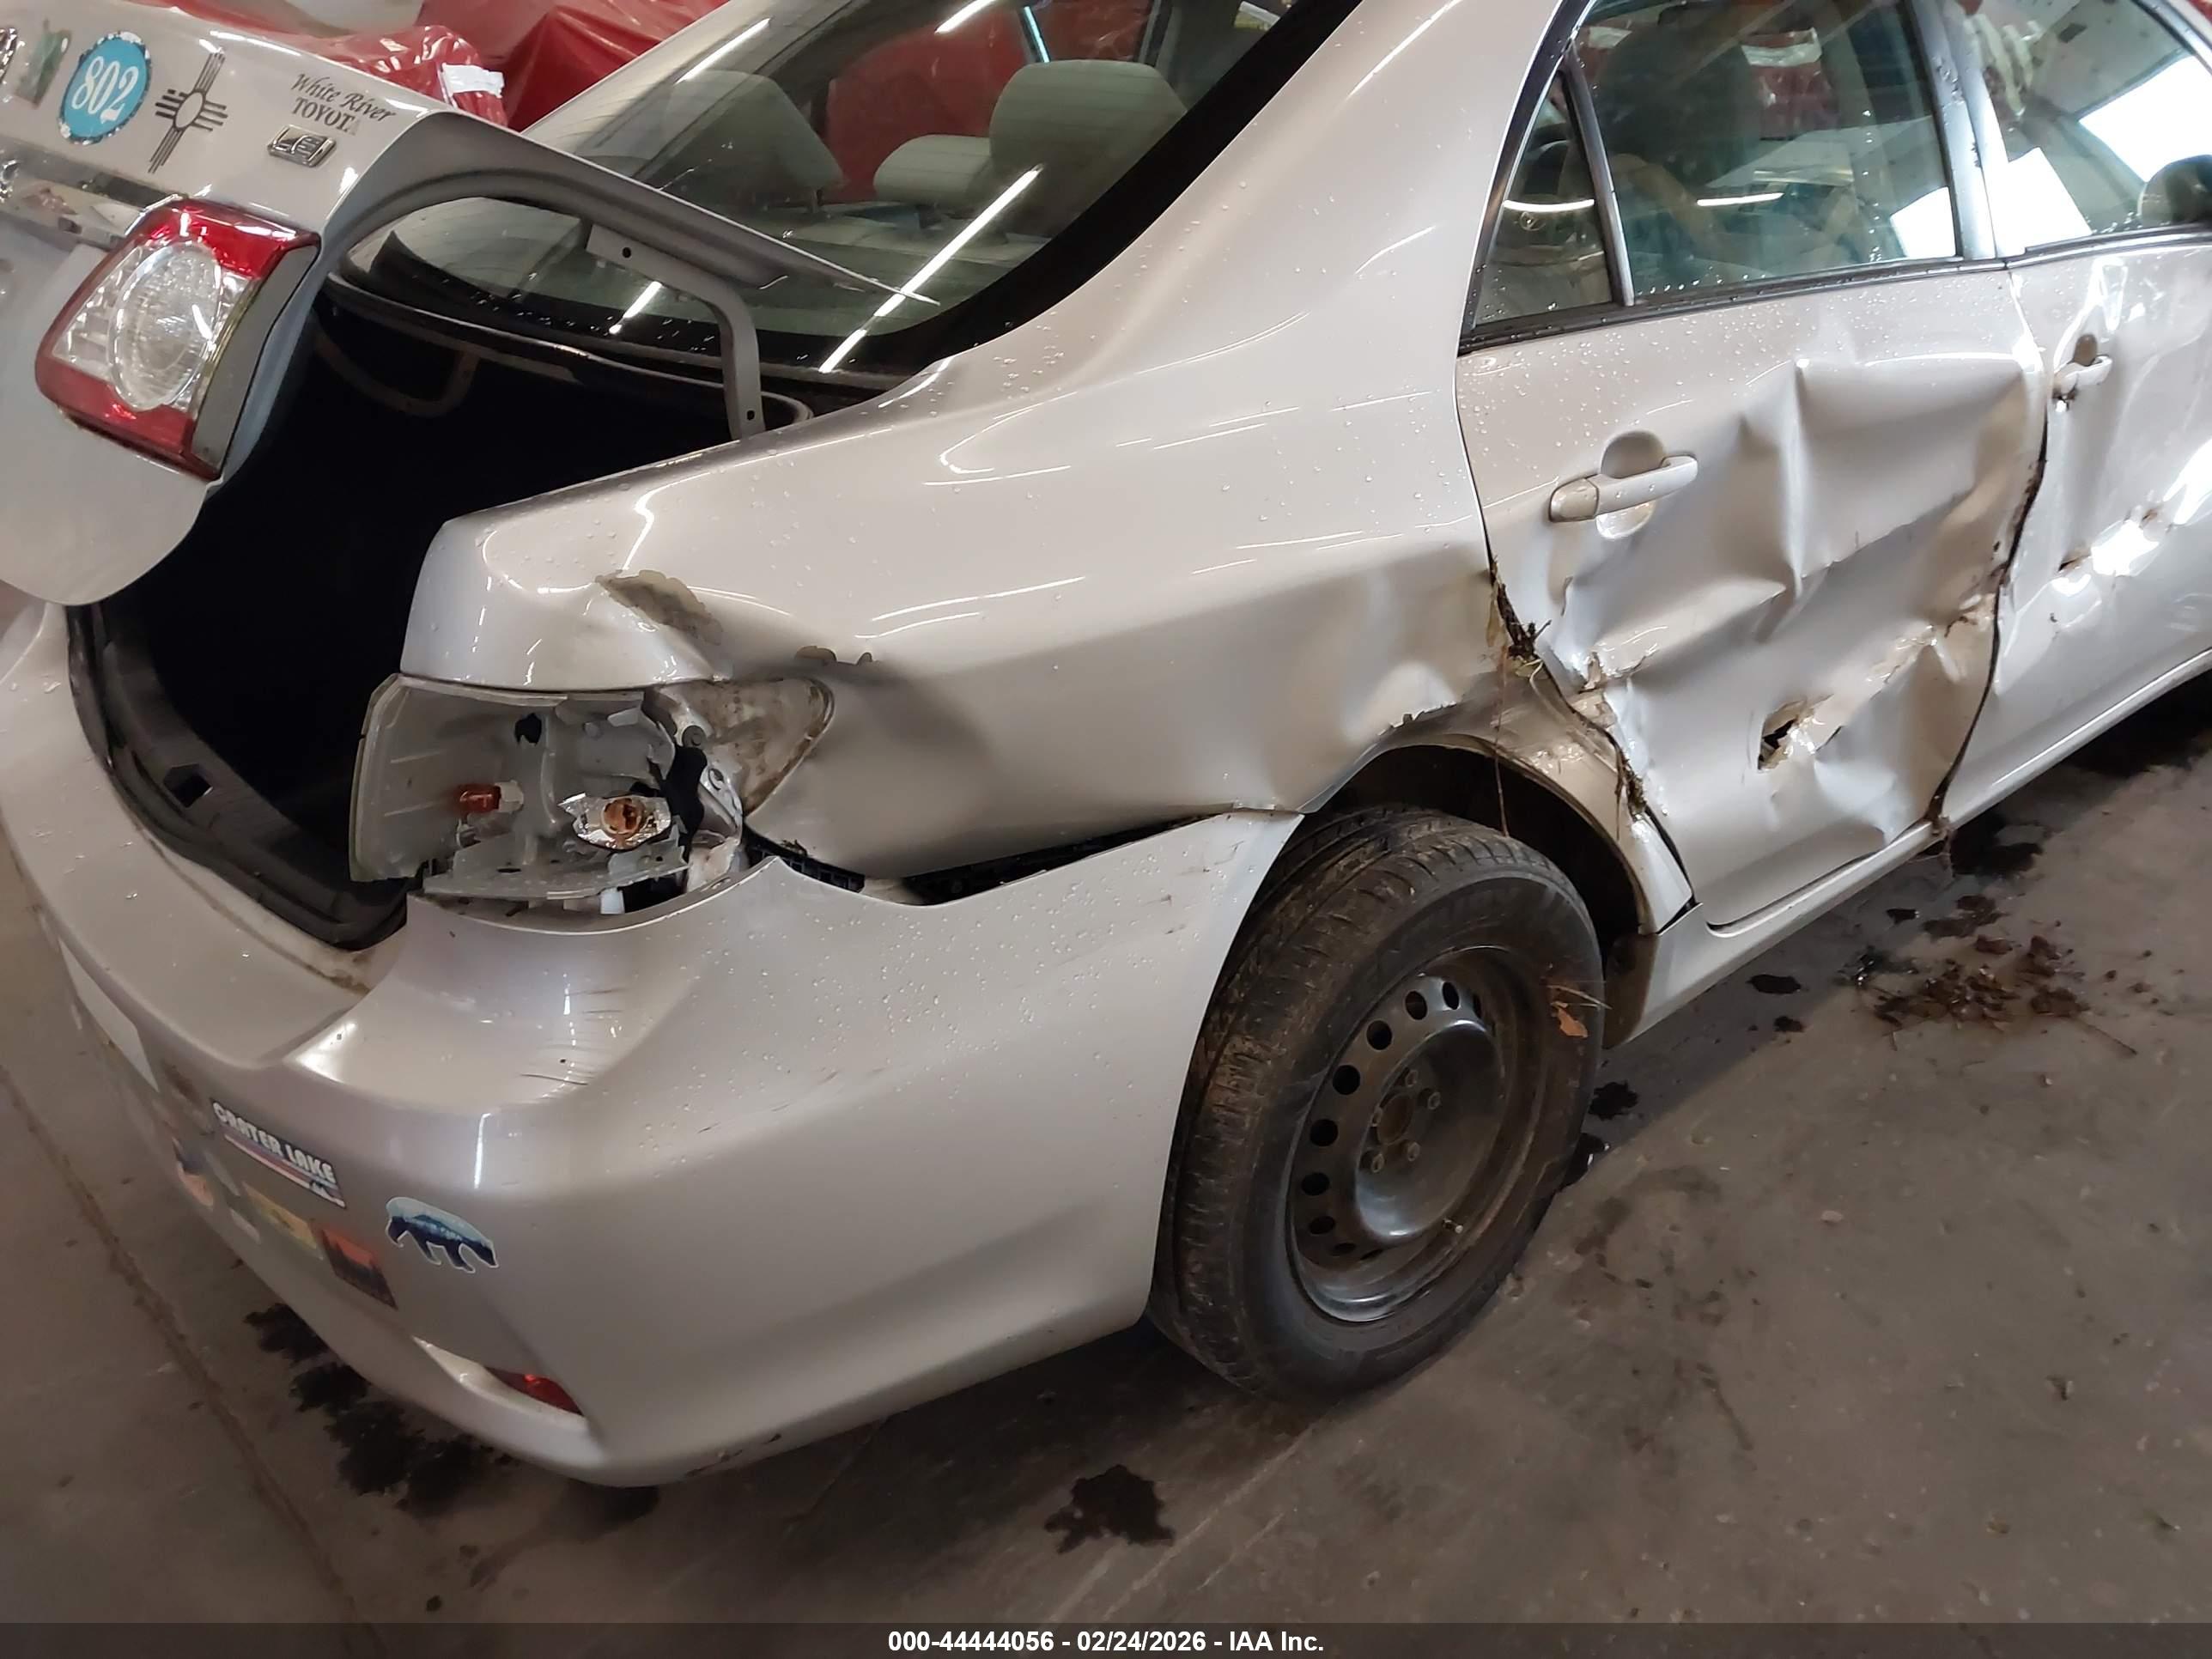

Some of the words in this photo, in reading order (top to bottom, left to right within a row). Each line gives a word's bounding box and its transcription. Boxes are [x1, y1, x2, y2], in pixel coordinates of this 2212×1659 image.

[71, 55, 139, 125] 802
[290, 73, 342, 102] White
[339, 92, 397, 122] River
[213, 1103, 285, 1157] CRATER
[285, 1144, 337, 1183] LAKE
